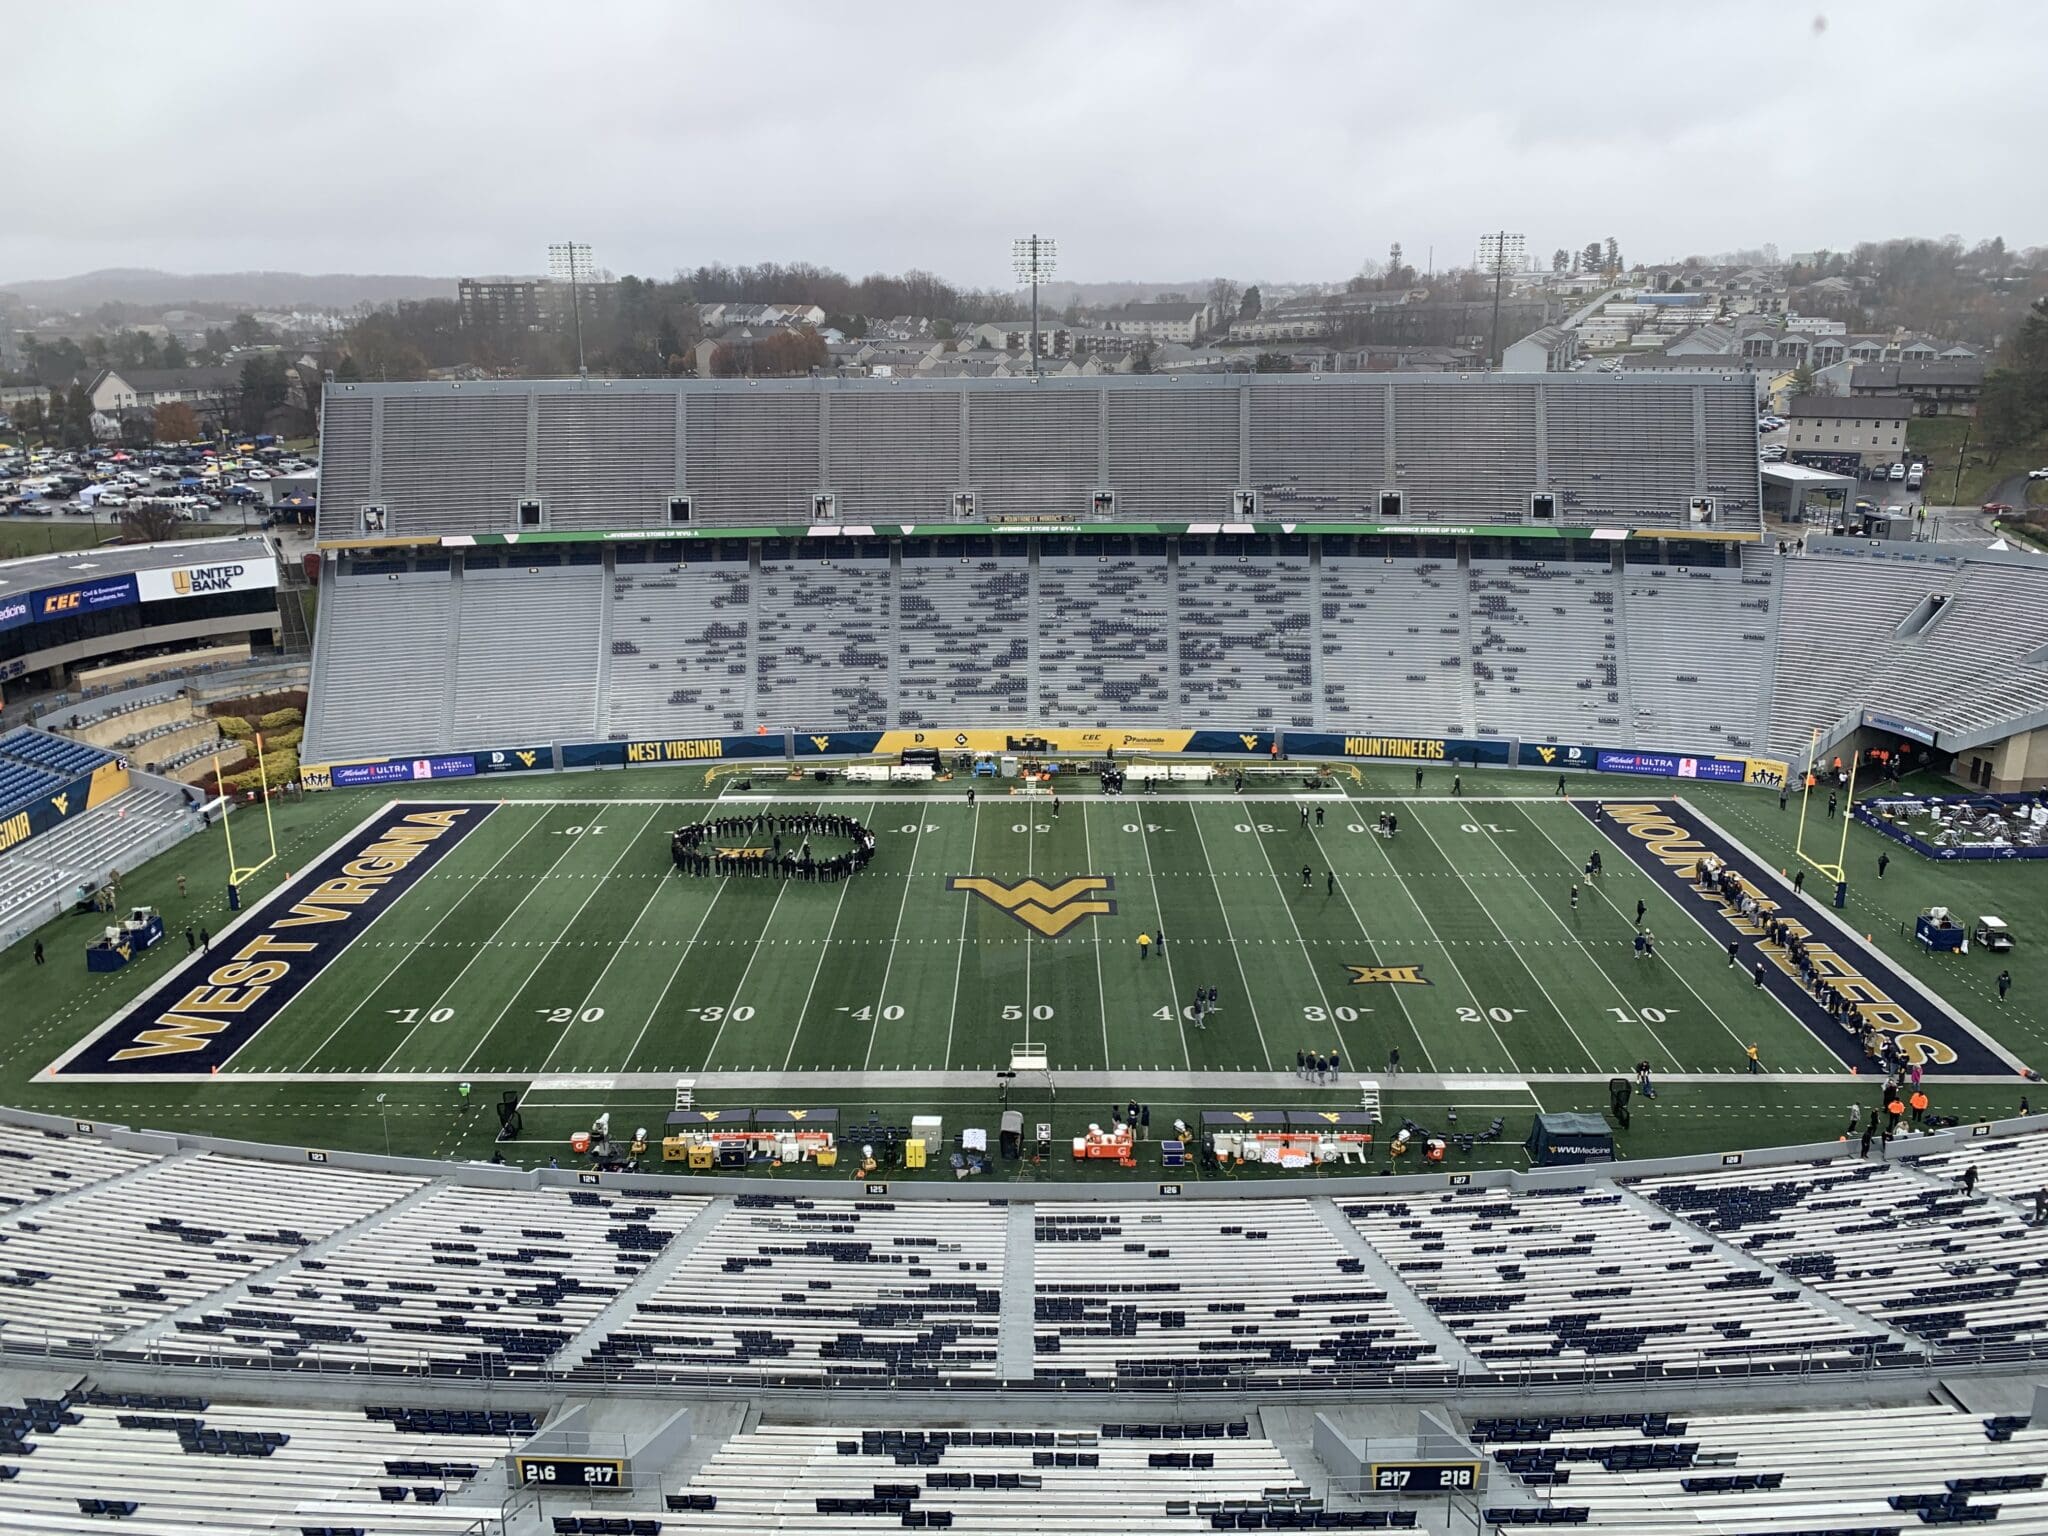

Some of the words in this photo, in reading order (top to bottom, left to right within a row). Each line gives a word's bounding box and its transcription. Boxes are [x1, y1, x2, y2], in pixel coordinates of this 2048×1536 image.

[190, 565, 244, 581] UNITED
[192, 578, 232, 592] BANK
[44, 590, 81, 614] CEC
[628, 742, 662, 762] WEST
[664, 739, 722, 760] VIRGINIA
[1344, 736, 1445, 759] MOUNTAINEERS
[376, 765, 408, 774] ULTRA
[1641, 758, 1673, 767] ULTRA
[108, 934, 319, 1062] WEST
[270, 808, 470, 929] VIRGINIA
[396, 1008, 455, 1023] 10
[547, 1007, 605, 1023] 20
[700, 1006, 755, 1022] 30
[851, 1005, 905, 1021] 40
[1001, 1005, 1055, 1021] 50
[1303, 1006, 1358, 1022] 30
[1455, 1007, 1513, 1022] 20
[1606, 1007, 1666, 1023] 10
[311, 1153, 324, 1161] 123
[583, 1175, 596, 1183] 124
[1453, 1176, 1467, 1184] 127
[870, 1185, 883, 1193] 125
[1163, 1186, 1177, 1194] 126
[525, 1464, 556, 1481] 216
[584, 1466, 614, 1483] 217
[1380, 1470, 1411, 1487] 217
[1439, 1470, 1471, 1486] 218
